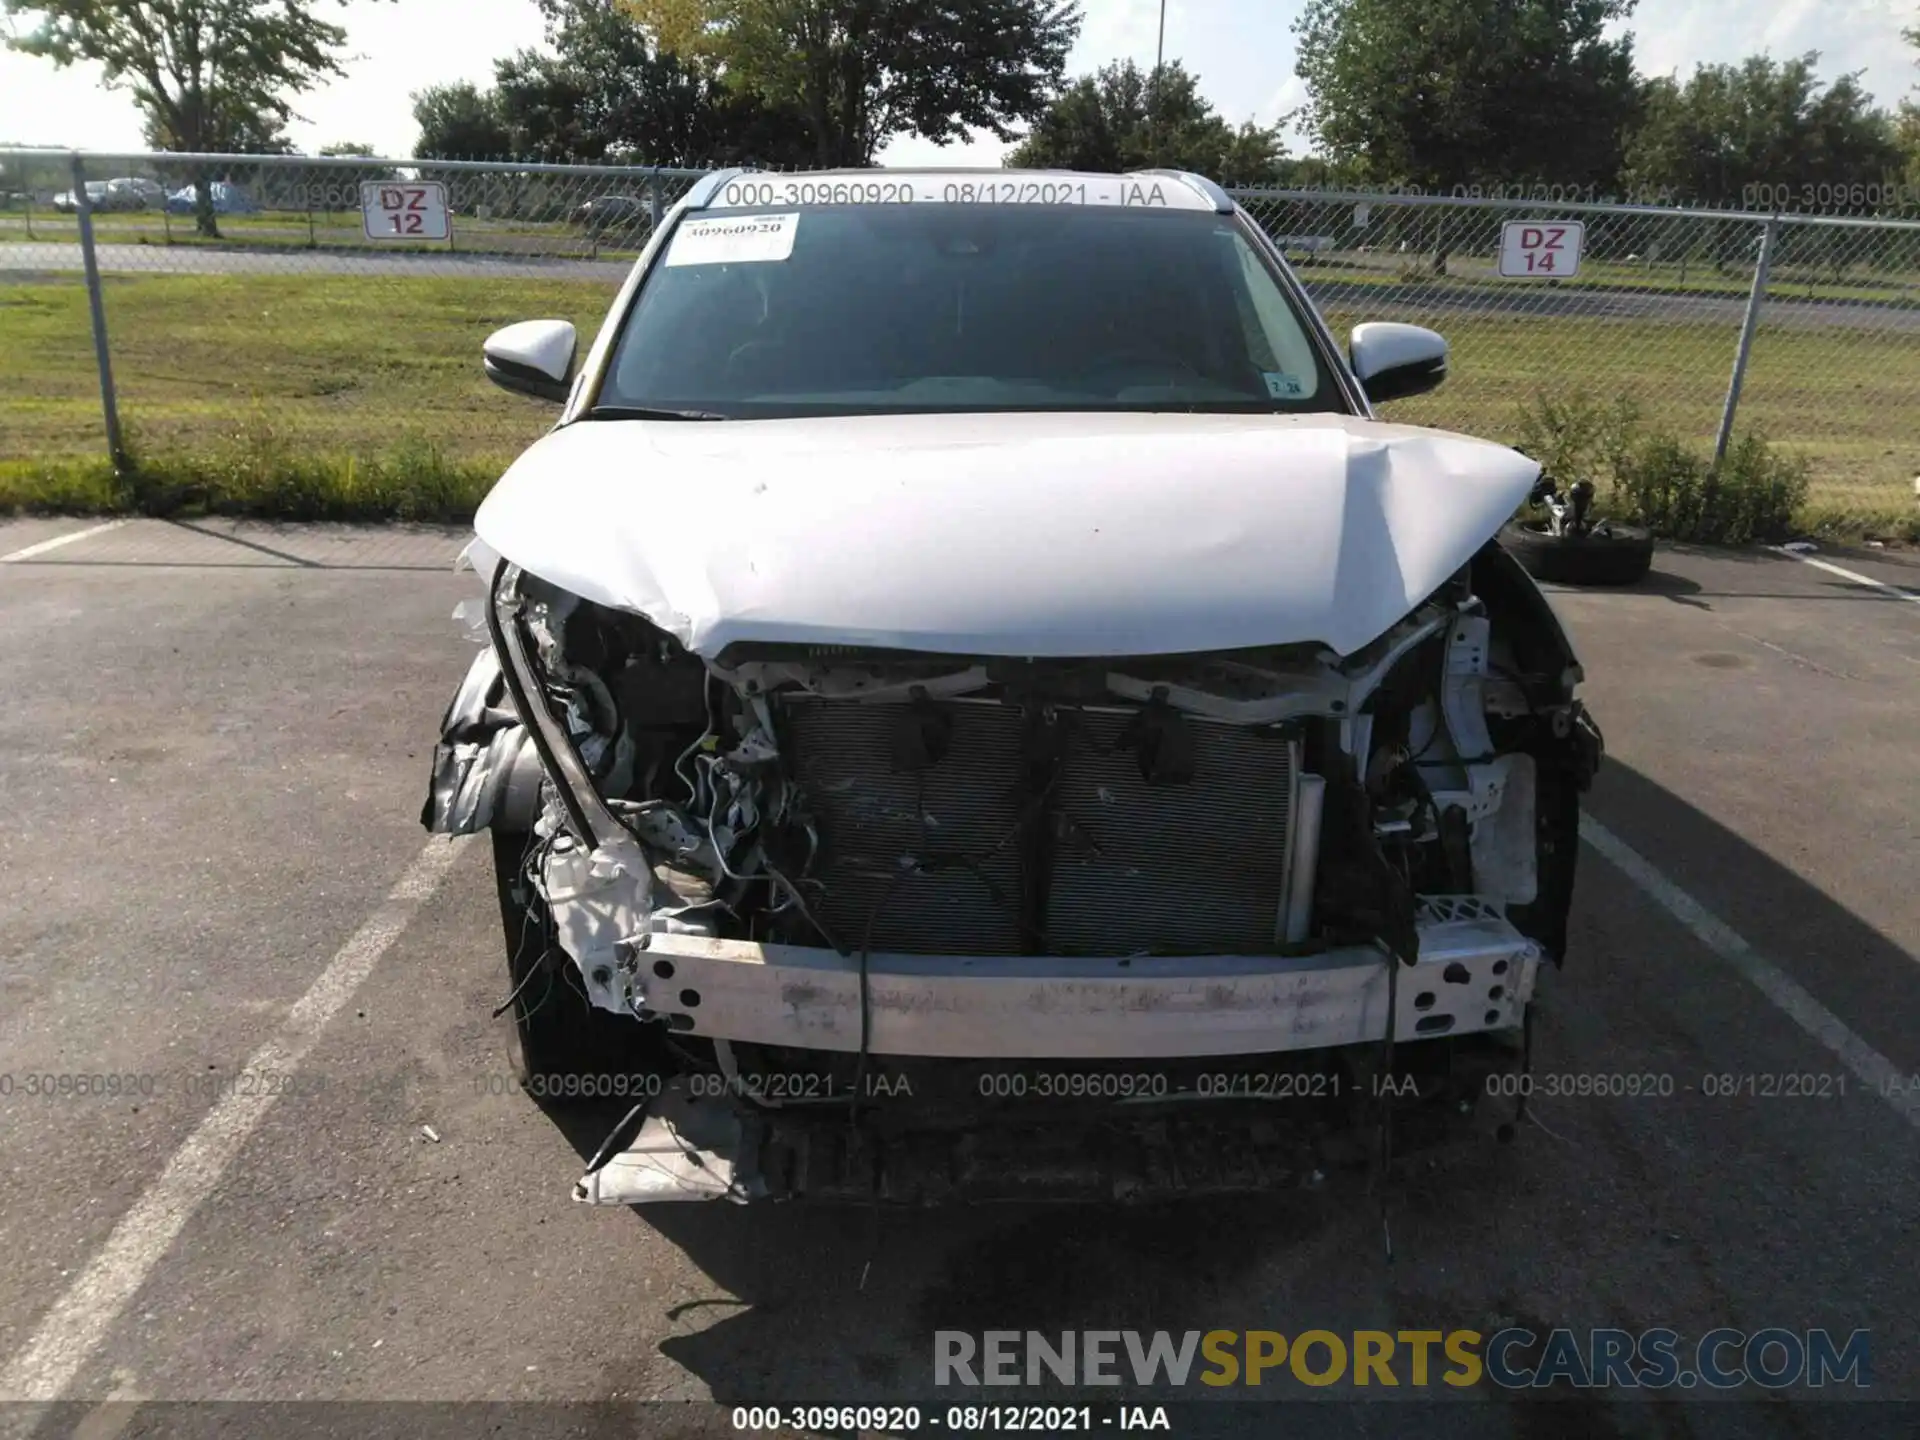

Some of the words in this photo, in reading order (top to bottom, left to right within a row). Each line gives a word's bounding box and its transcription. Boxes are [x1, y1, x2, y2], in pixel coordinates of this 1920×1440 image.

[381, 189, 428, 210] DZ
[388, 213, 424, 234] 12
[1521, 228, 1566, 249] DZ
[1524, 251, 1556, 272] 14
